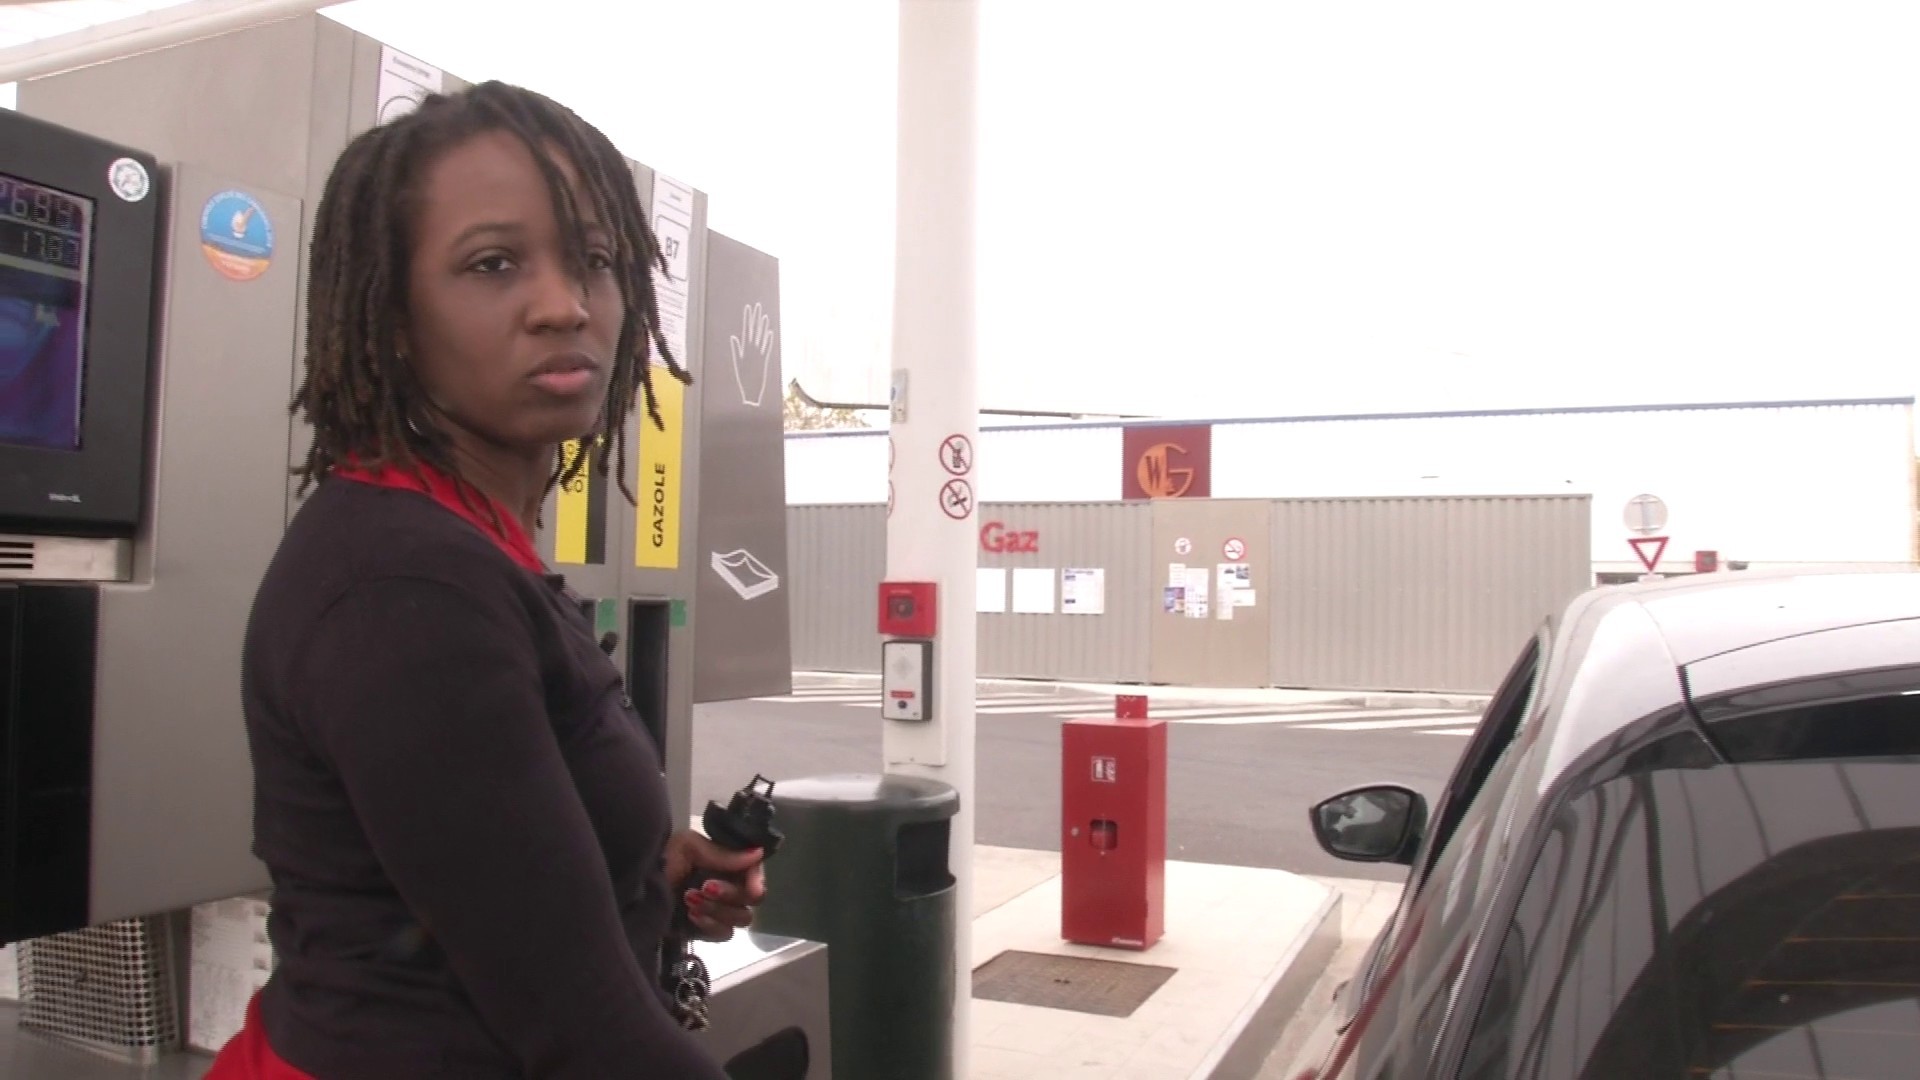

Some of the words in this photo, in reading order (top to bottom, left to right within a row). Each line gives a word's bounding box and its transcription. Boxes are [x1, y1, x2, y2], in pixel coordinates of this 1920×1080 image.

[665, 236, 680, 261] B7
[652, 462, 666, 548] GAZOLE
[980, 520, 1040, 554] Gaz
